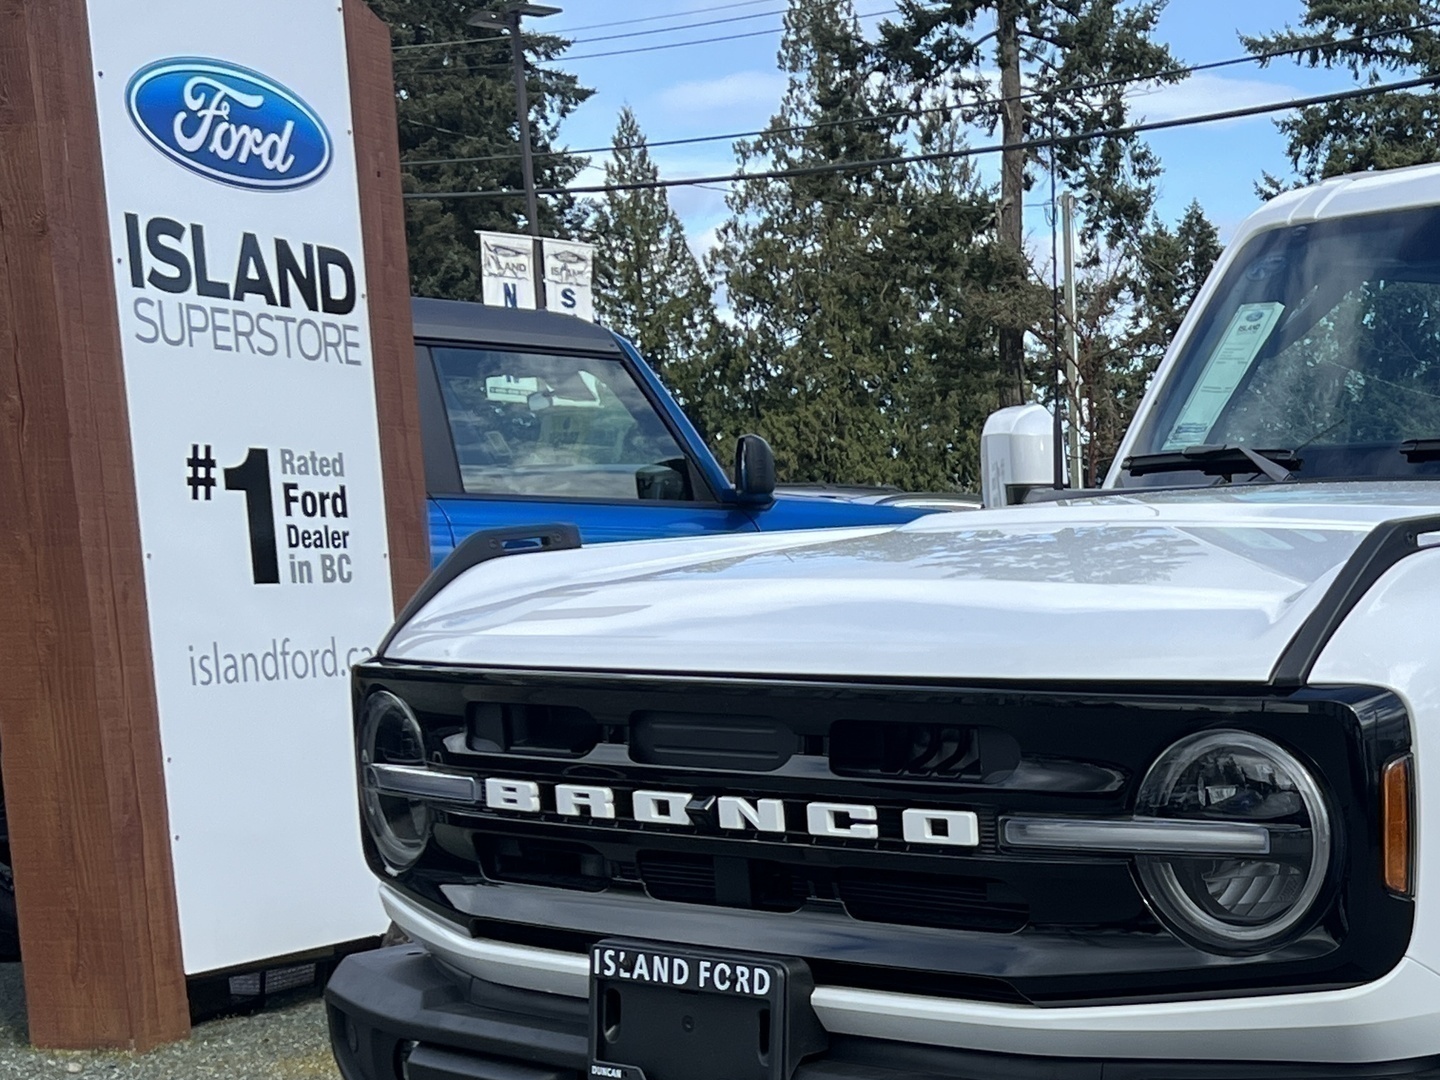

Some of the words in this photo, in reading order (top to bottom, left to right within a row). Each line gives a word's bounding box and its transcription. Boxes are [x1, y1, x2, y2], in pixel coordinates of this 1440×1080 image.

[173, 76, 295, 173] Ford
[124, 211, 356, 315] ISLAND
[561, 287, 577, 309] S
[133, 297, 362, 366] SUPERSTORE
[280, 448, 345, 477] Rated
[283, 482, 348, 518] Ford
[286, 524, 350, 549] Dealer
[289, 553, 313, 584] in
[321, 553, 352, 584] BC
[485, 777, 980, 846] BRONCO
[594, 948, 689, 986] ISLAND
[699, 961, 770, 996] FORD
[591, 1065, 621, 1079] DUNCAN
